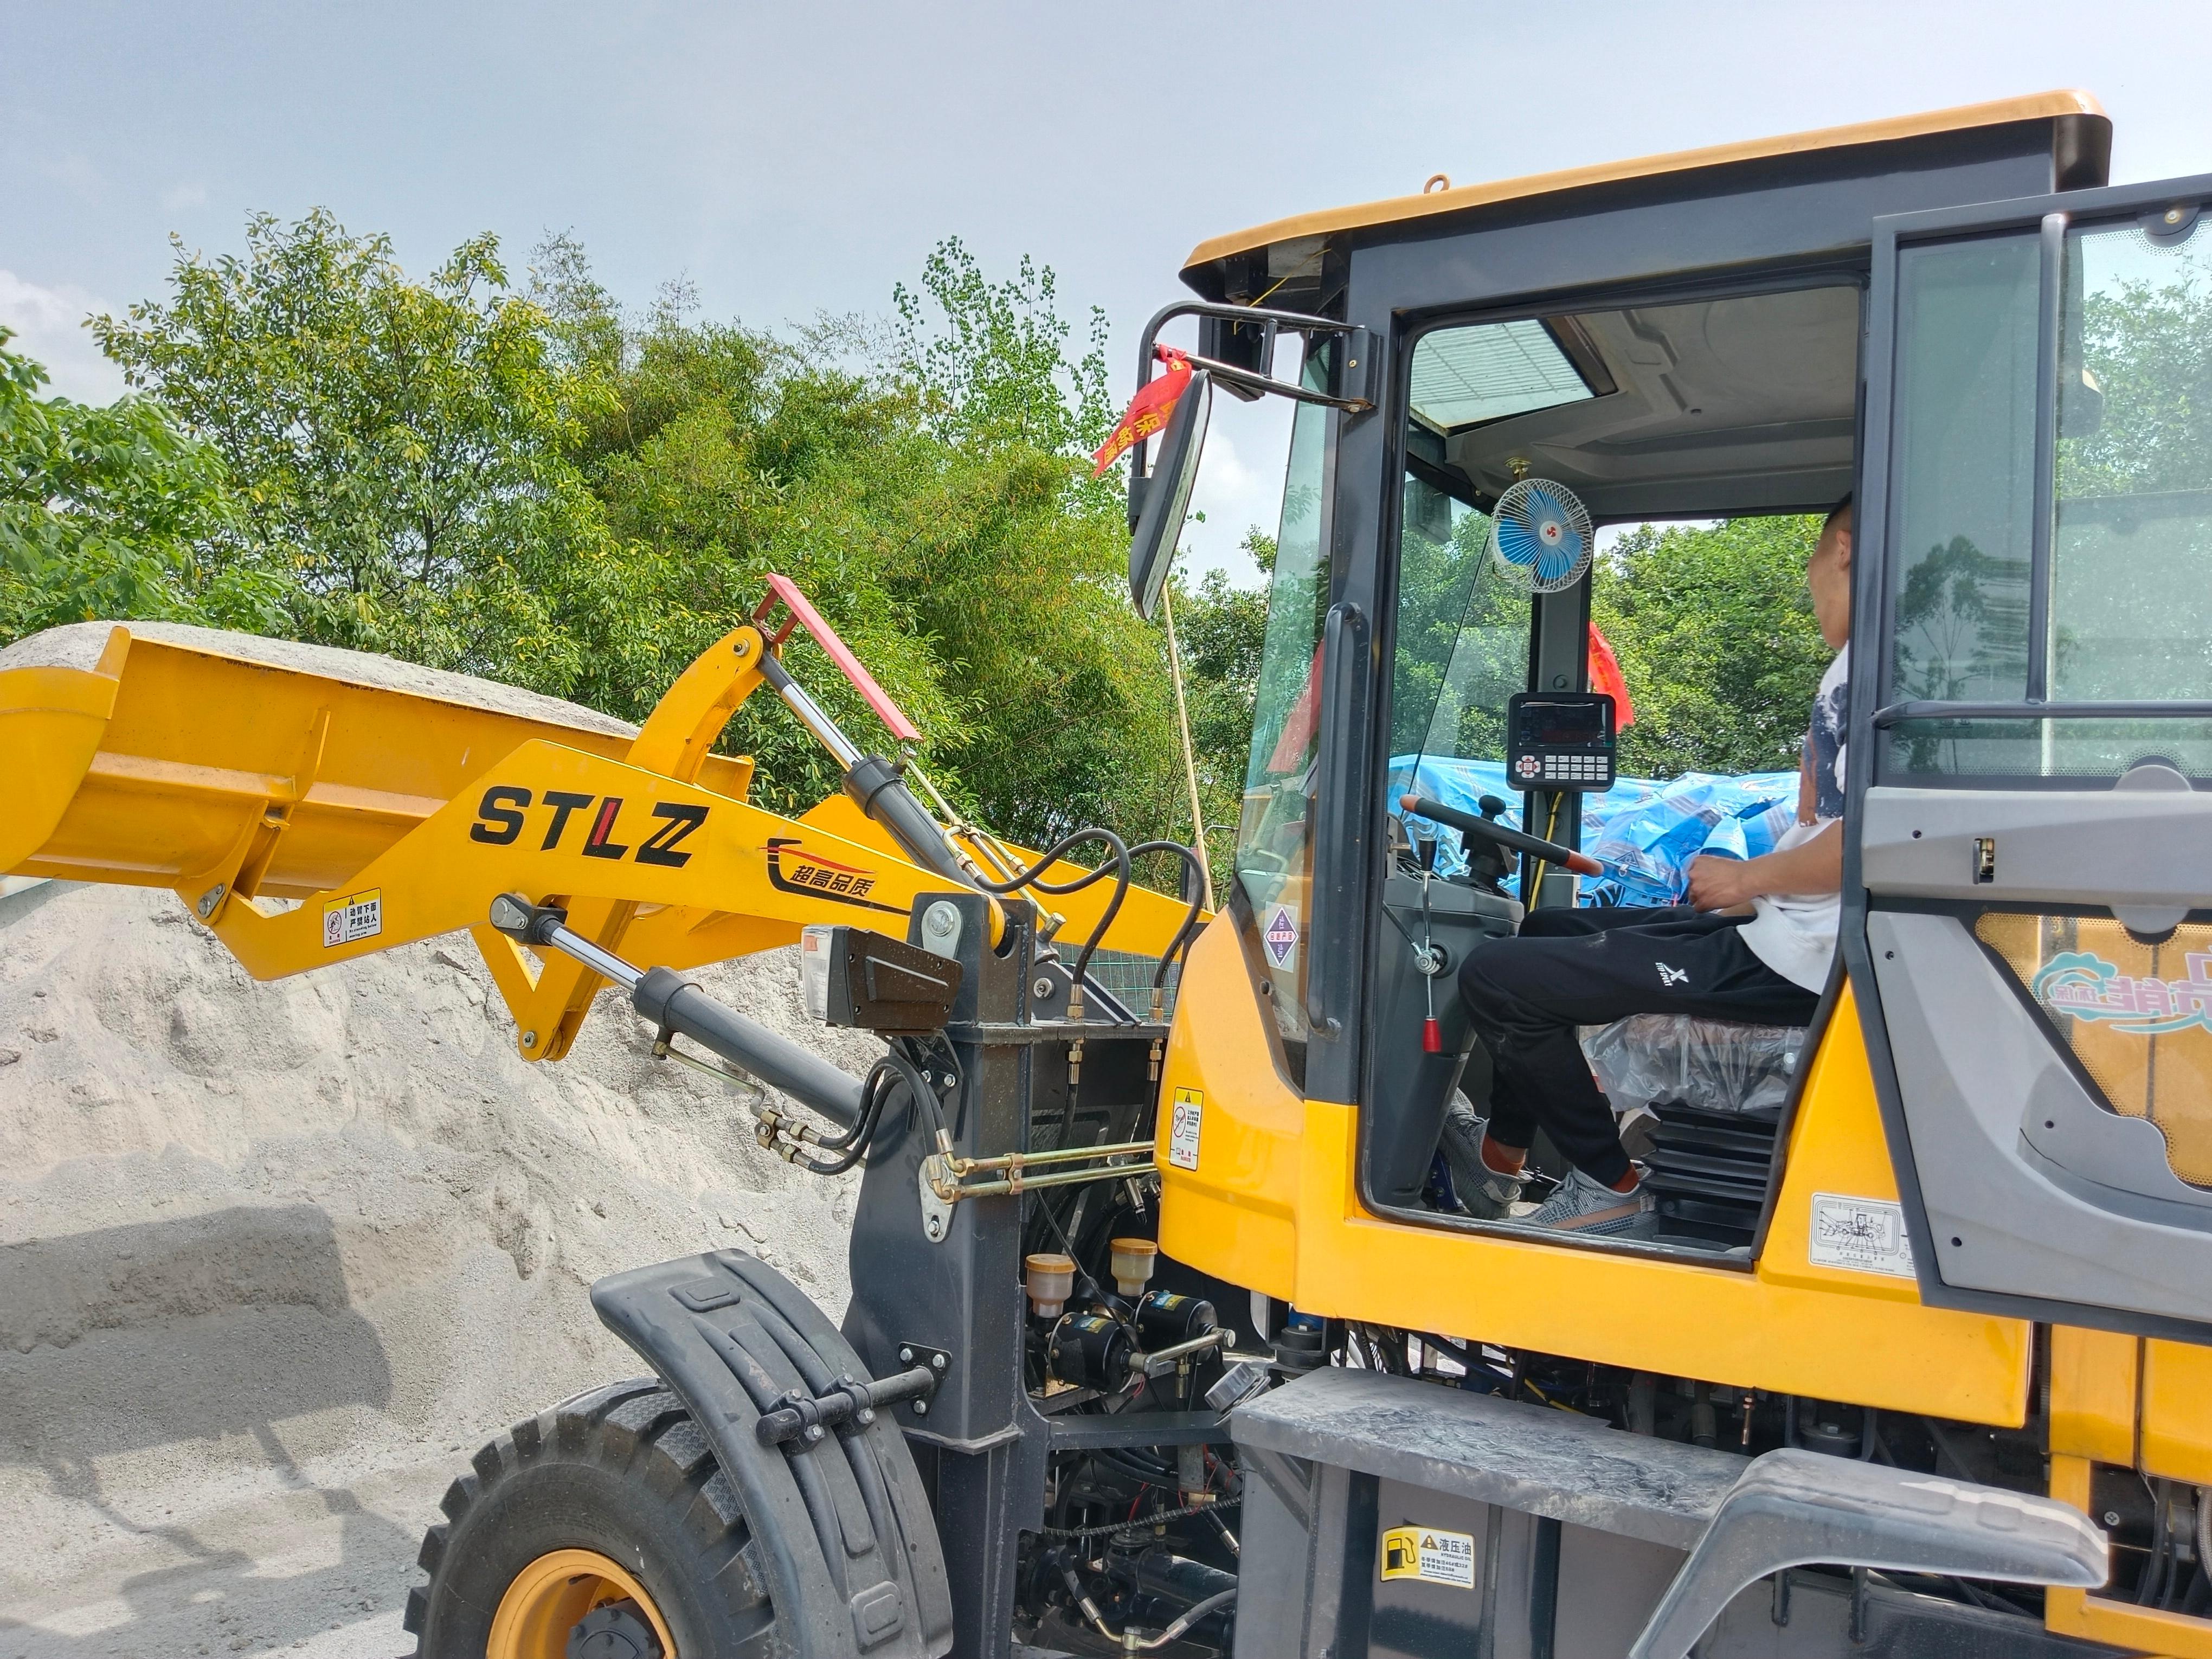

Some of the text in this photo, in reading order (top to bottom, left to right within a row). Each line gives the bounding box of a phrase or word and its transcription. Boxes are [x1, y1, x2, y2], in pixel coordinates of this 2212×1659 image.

[470, 786, 711, 868] STLZ
[789, 865, 877, 897] 超高品质
[350, 902, 376, 916] 动臂下面
[350, 914, 377, 928] 严禁站人
[1439, 1538, 1471, 1555] 液压油
